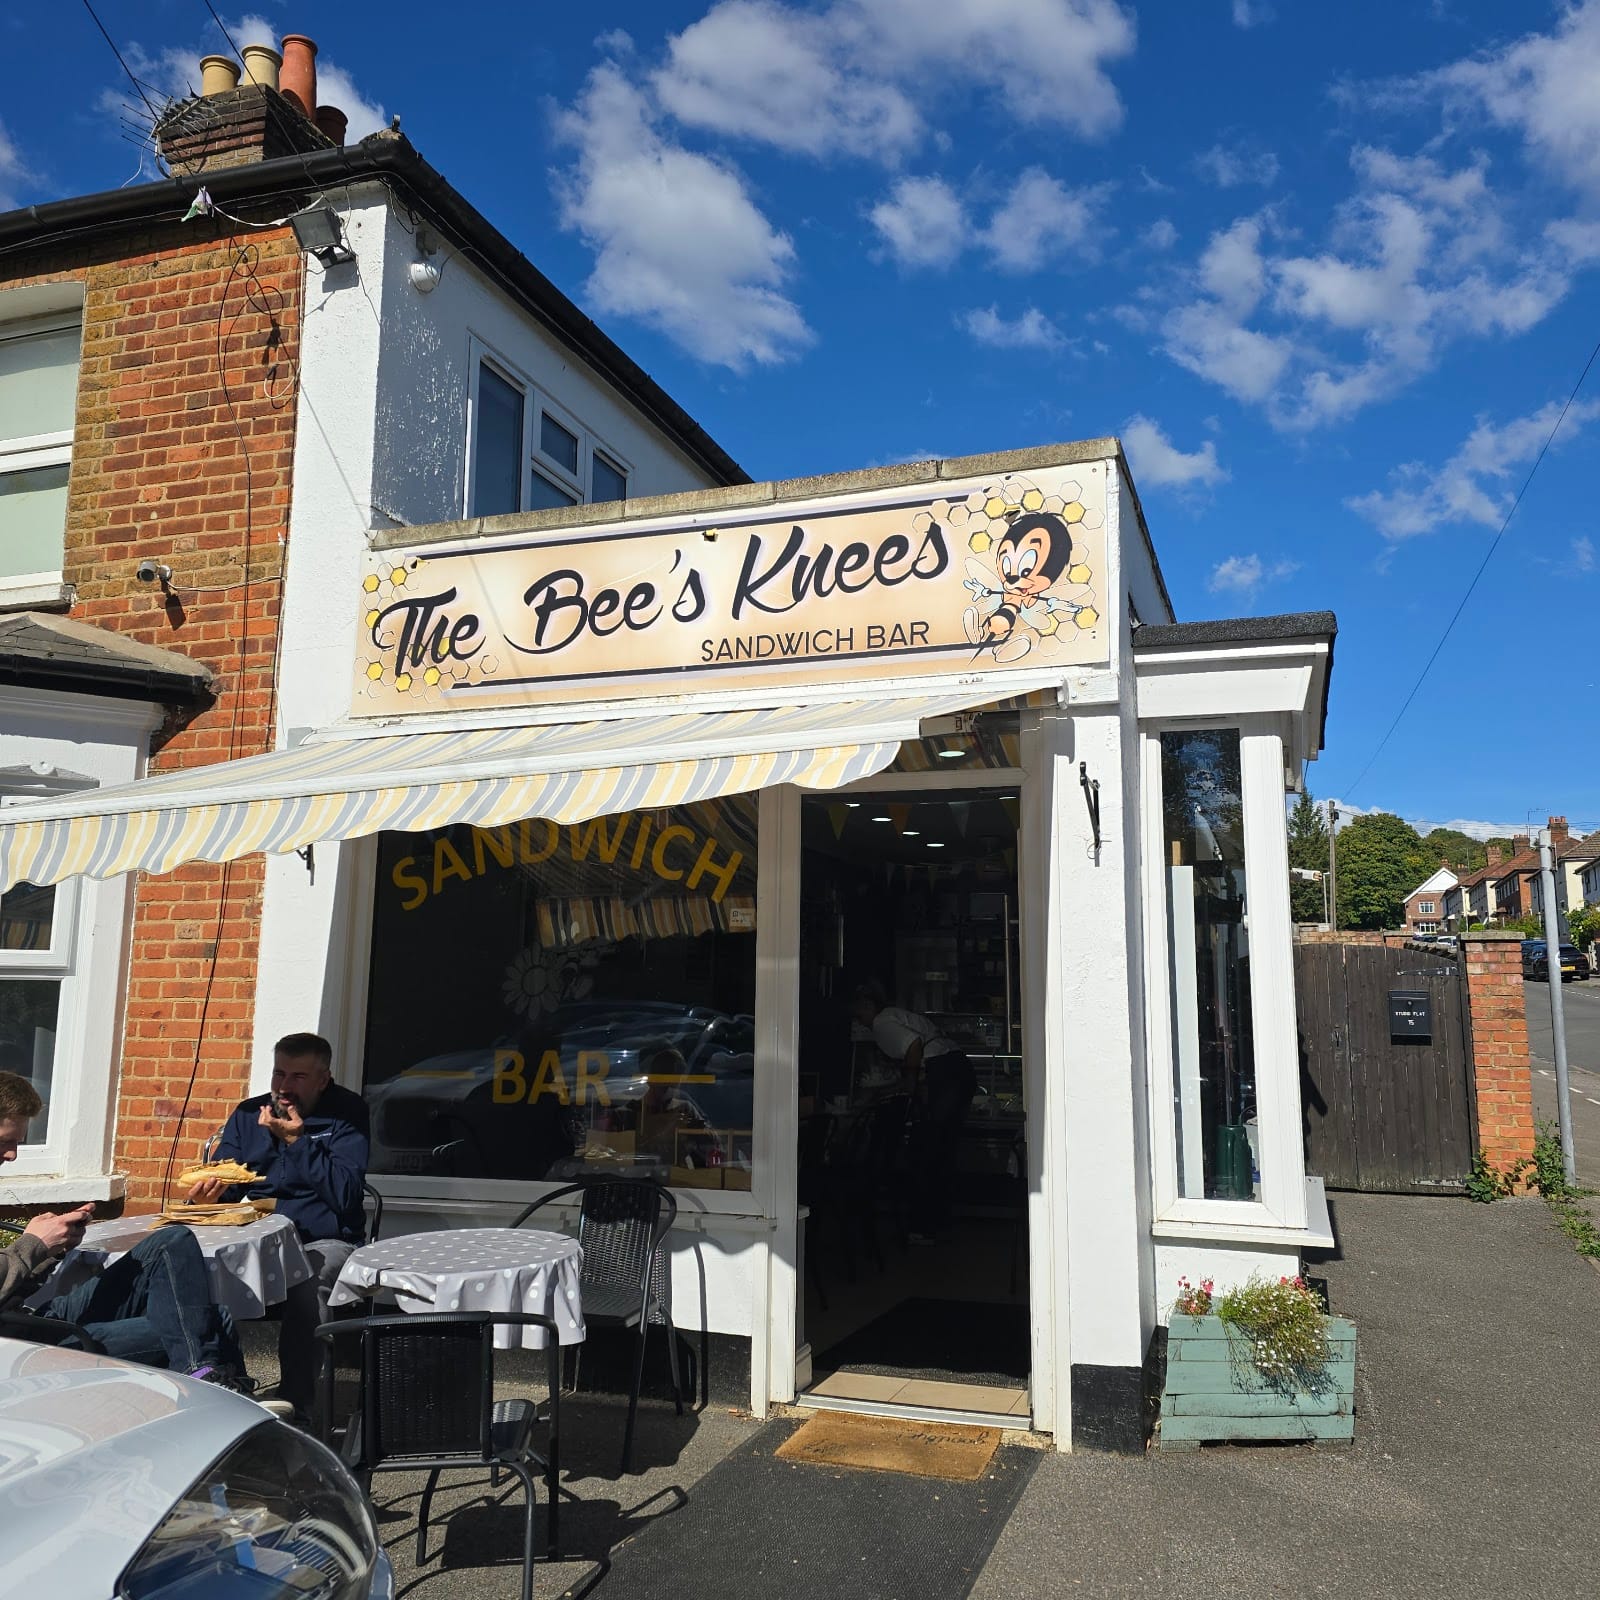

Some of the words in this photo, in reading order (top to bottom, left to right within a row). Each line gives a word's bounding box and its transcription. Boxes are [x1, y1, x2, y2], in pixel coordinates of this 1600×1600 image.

[371, 586, 487, 677] The
[503, 549, 706, 655] Bee's
[731, 522, 949, 620] Knees
[701, 626, 854, 663] SANDWICH
[866, 621, 930, 649] BAR
[392, 813, 744, 911] SANDWICH
[492, 1049, 612, 1107] BAR
